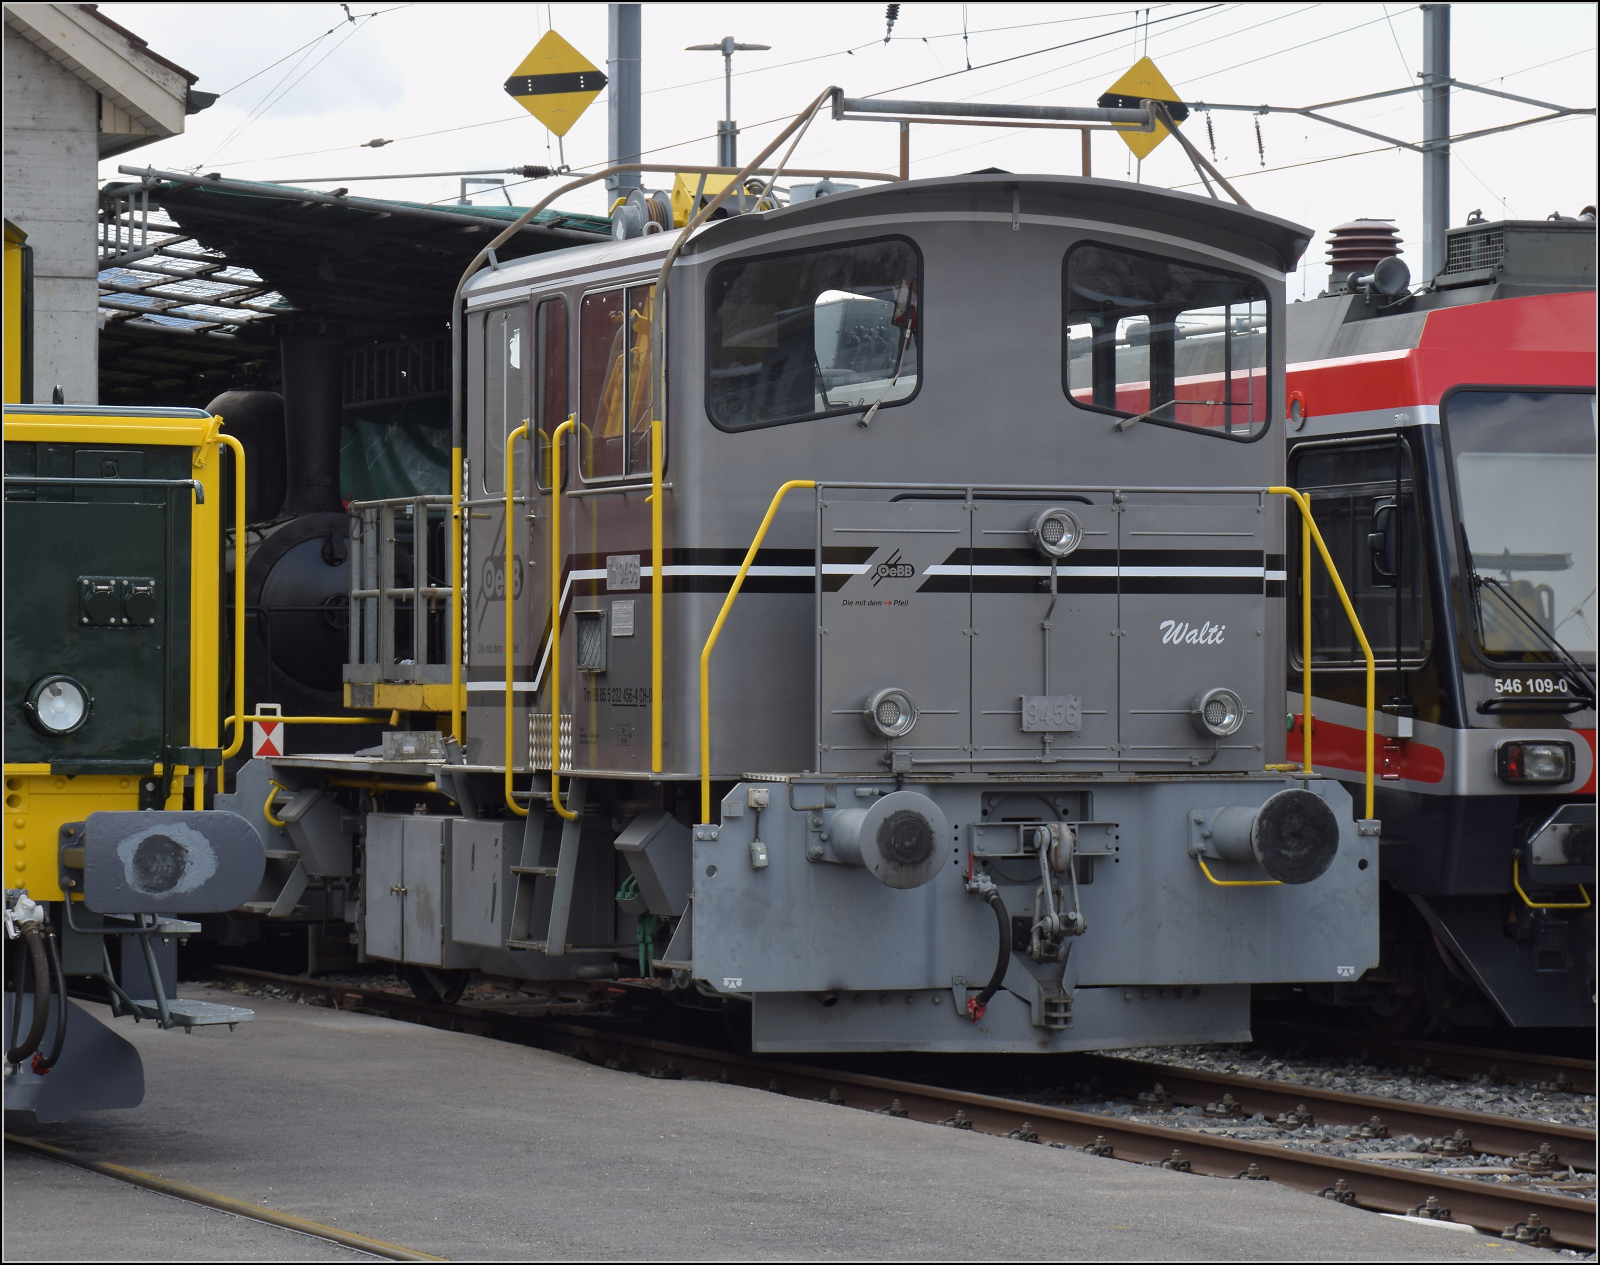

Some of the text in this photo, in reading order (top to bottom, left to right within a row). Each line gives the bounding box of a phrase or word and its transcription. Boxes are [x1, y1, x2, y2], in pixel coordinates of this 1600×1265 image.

[482, 558, 521, 598] OeB
[877, 564, 914, 578] OeBB
[842, 599, 909, 607] Die mit dem Pfeil
[1159, 619, 1226, 645] Walti
[1494, 678, 1568, 693] 546 109-0
[600, 687, 607, 702] 85
[612, 687, 622, 703] 232
[623, 687, 638, 703] 456-4
[1026, 701, 1078, 725] 9456
